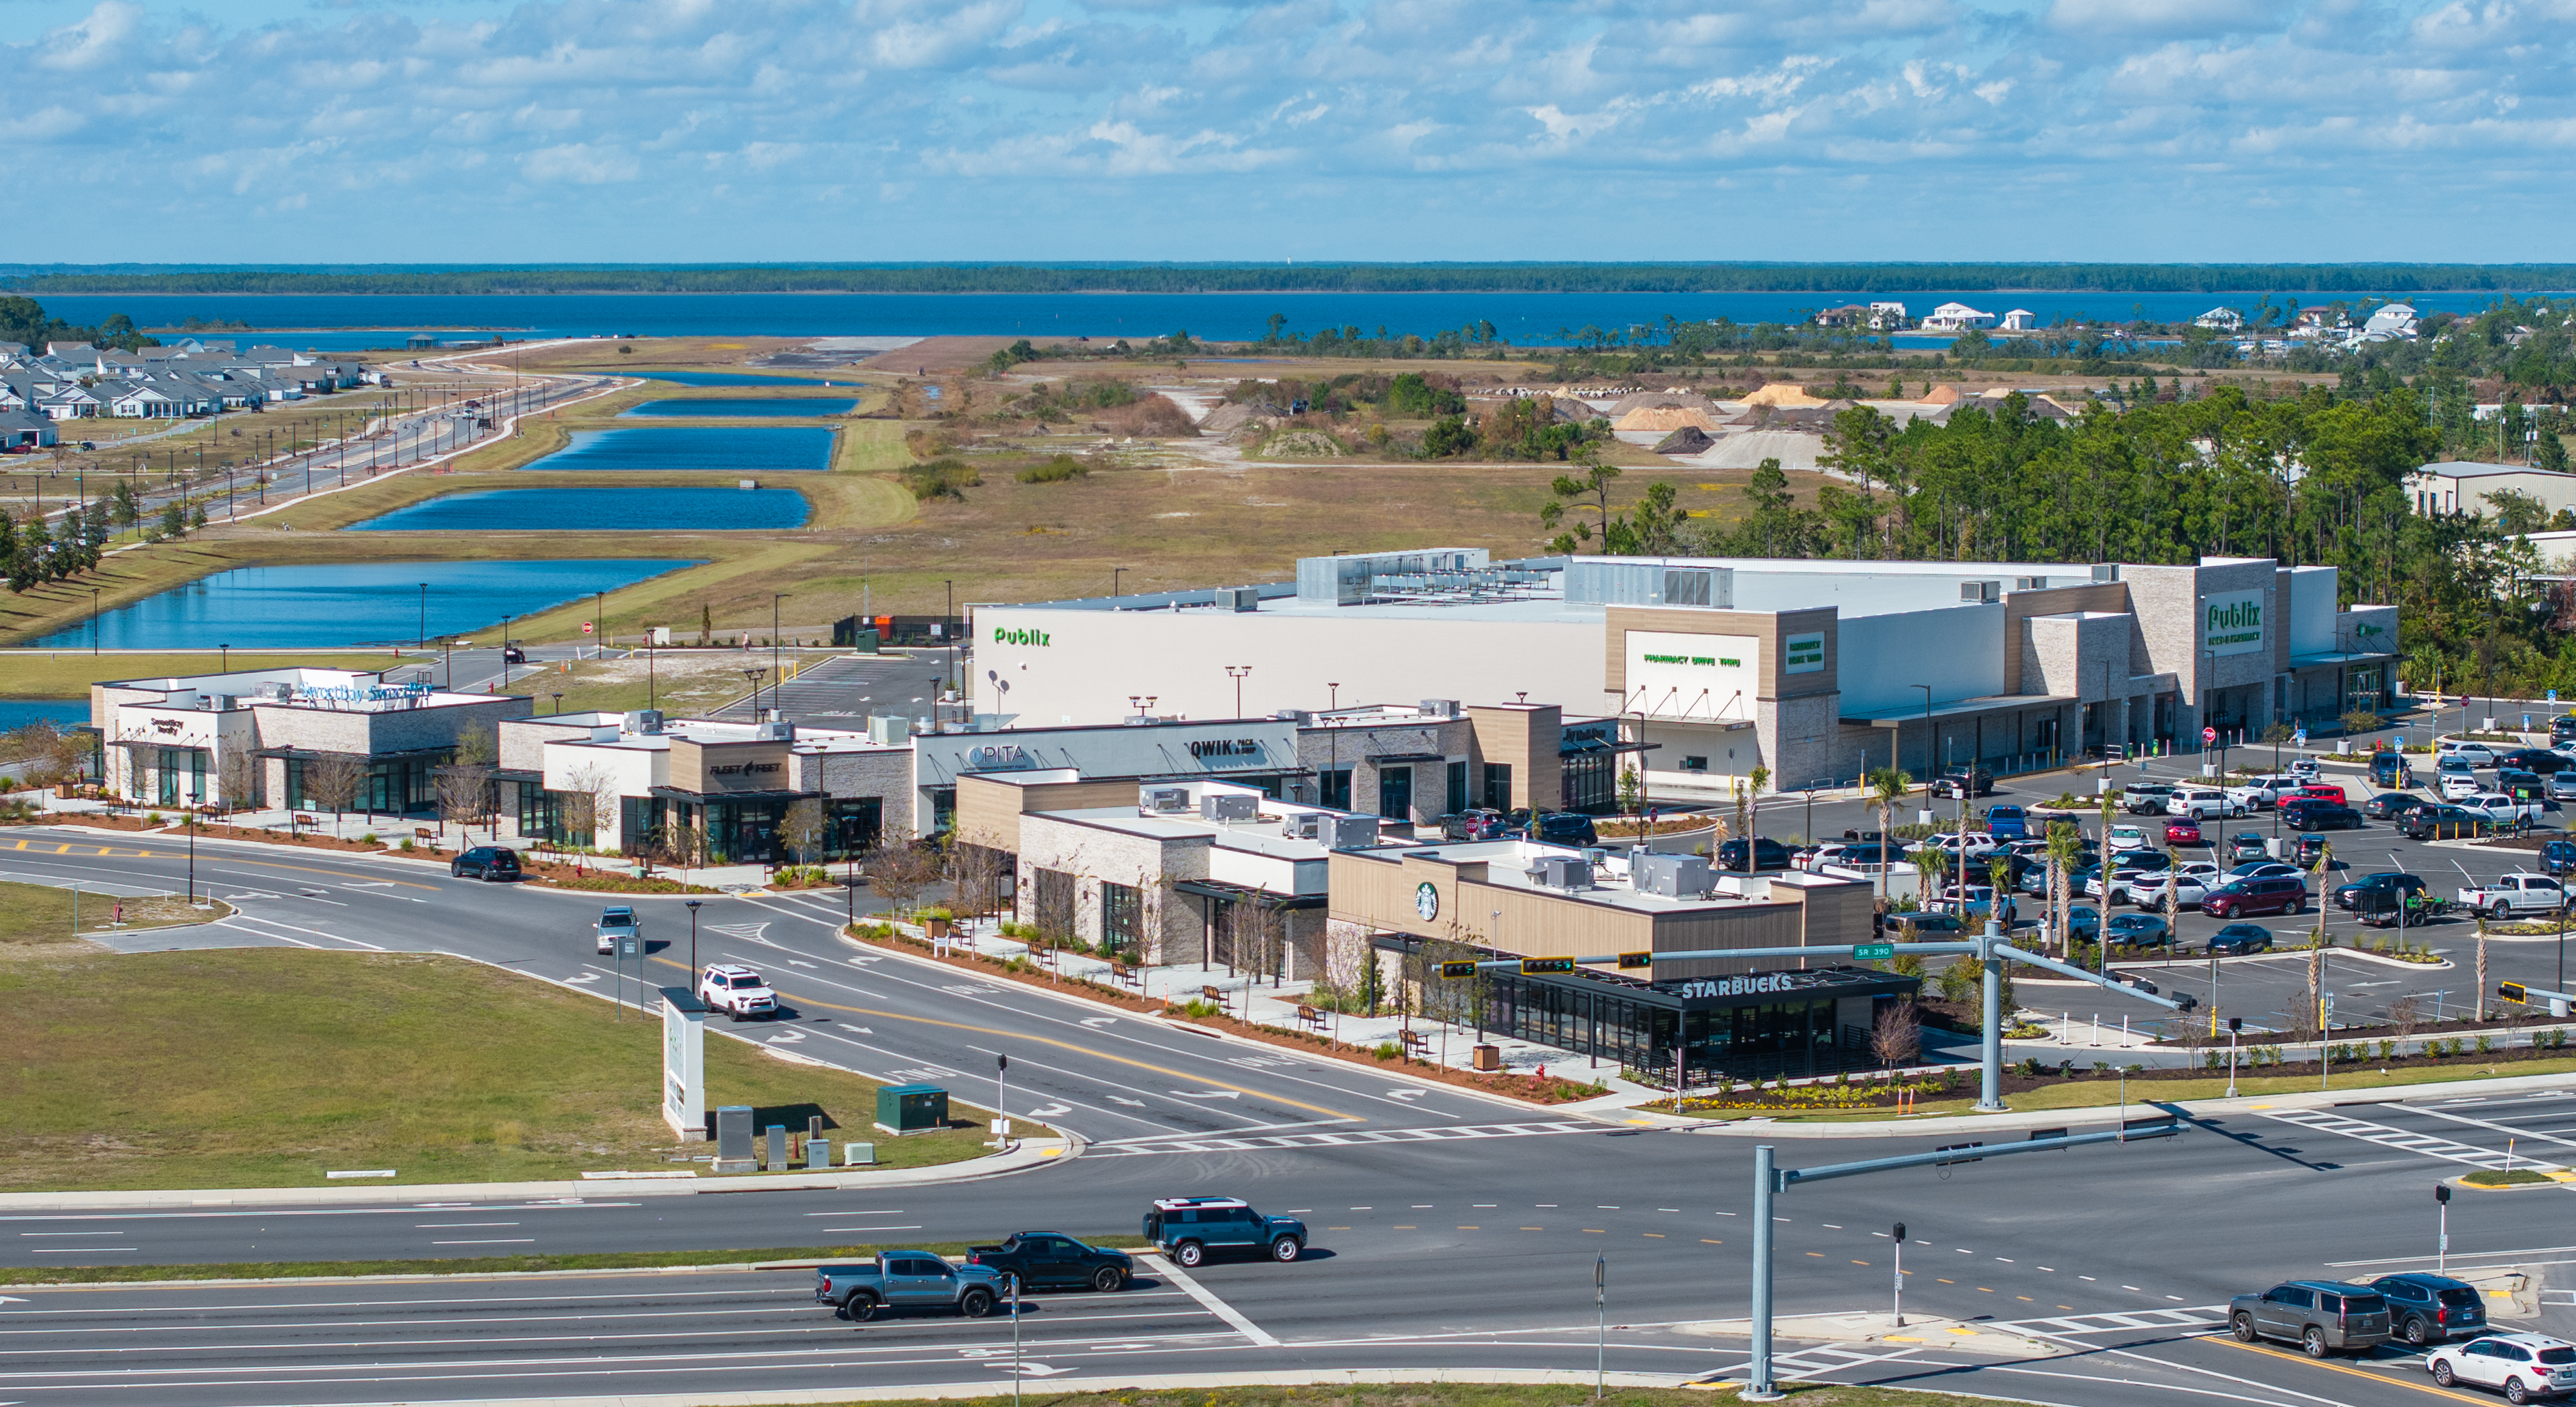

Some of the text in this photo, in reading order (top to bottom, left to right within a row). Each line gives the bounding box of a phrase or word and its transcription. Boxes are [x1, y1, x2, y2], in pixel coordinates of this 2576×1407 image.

[2209, 601, 2260, 631] Publix
[995, 626, 1050, 647] Publix
[1644, 654, 1741, 668] PHARMACY DRIVE THRU
[299, 682, 364, 704] SweetBay
[151, 718, 184, 729] SweetBay
[1191, 740, 1232, 759] QWIK
[710, 763, 782, 774] FLEET FEET
[941, 984, 1011, 995] ONLY
[1682, 975, 1792, 999] STARBUCKS
[1227, 1055, 1307, 1067] ONLY
[883, 1068, 957, 1082] ONLY
